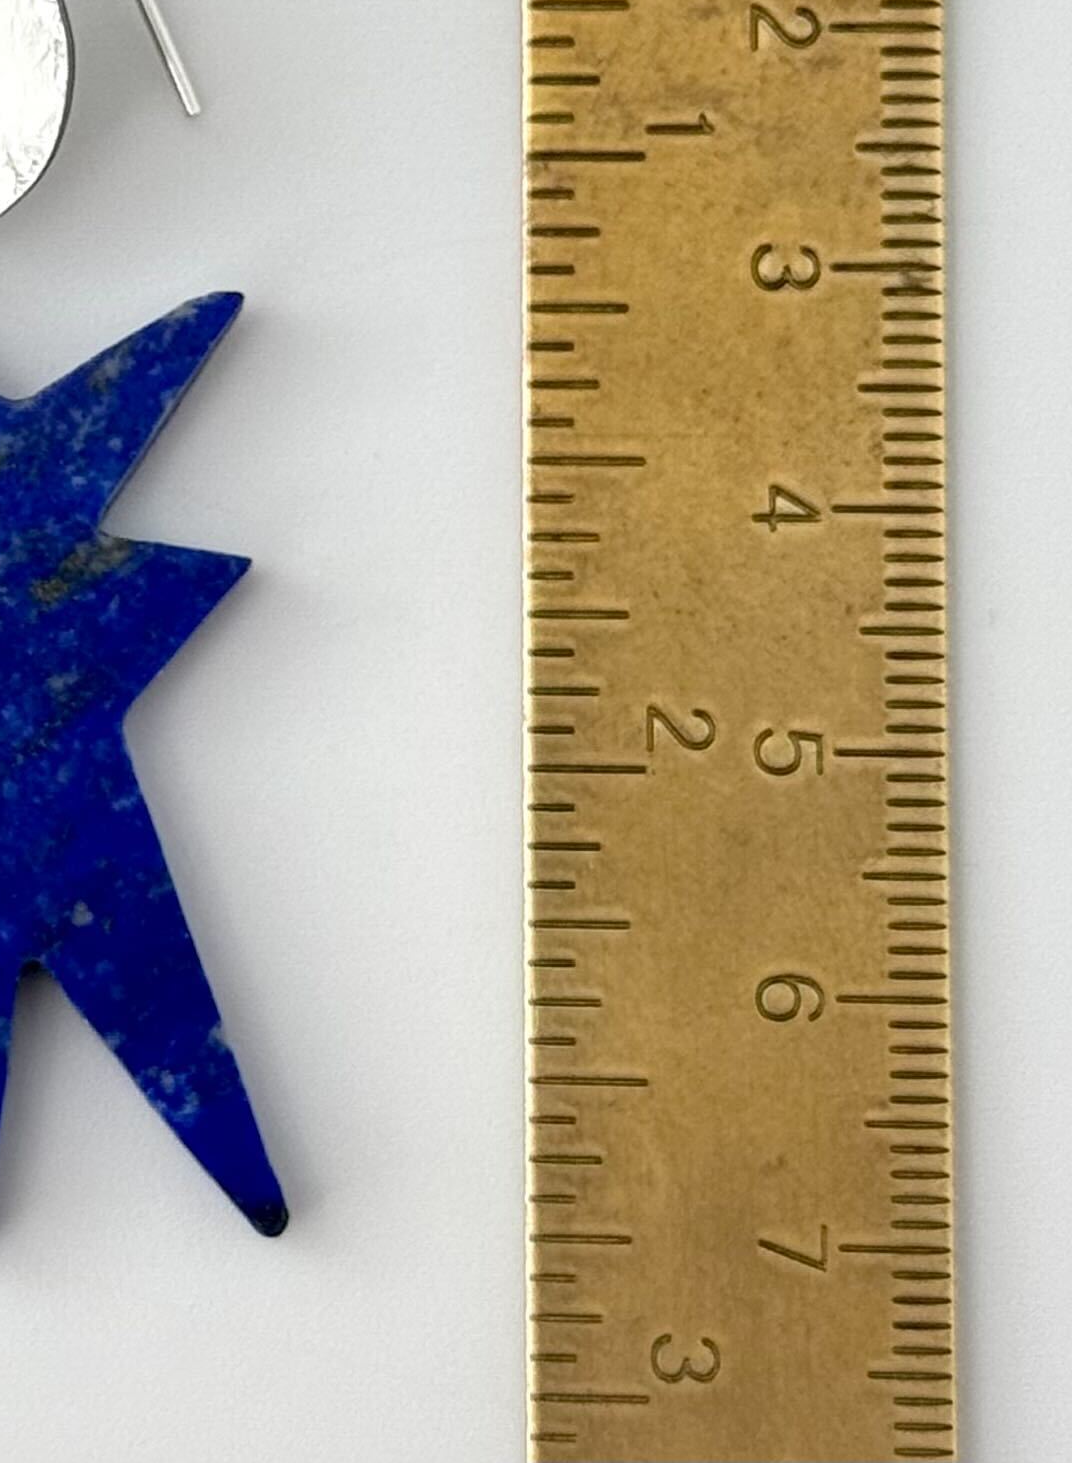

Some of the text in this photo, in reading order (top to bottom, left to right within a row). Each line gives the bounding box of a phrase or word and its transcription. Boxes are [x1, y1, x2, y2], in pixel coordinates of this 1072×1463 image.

[749, 3, 823, 53] 2
[644, 111, 715, 135] 1
[749, 242, 821, 291] 3
[751, 483, 822, 533] 4
[645, 704, 716, 754] 2
[752, 727, 824, 777] 5
[754, 973, 826, 1023] 6
[757, 1224, 827, 1272] 7
[650, 1332, 721, 1384] 3
